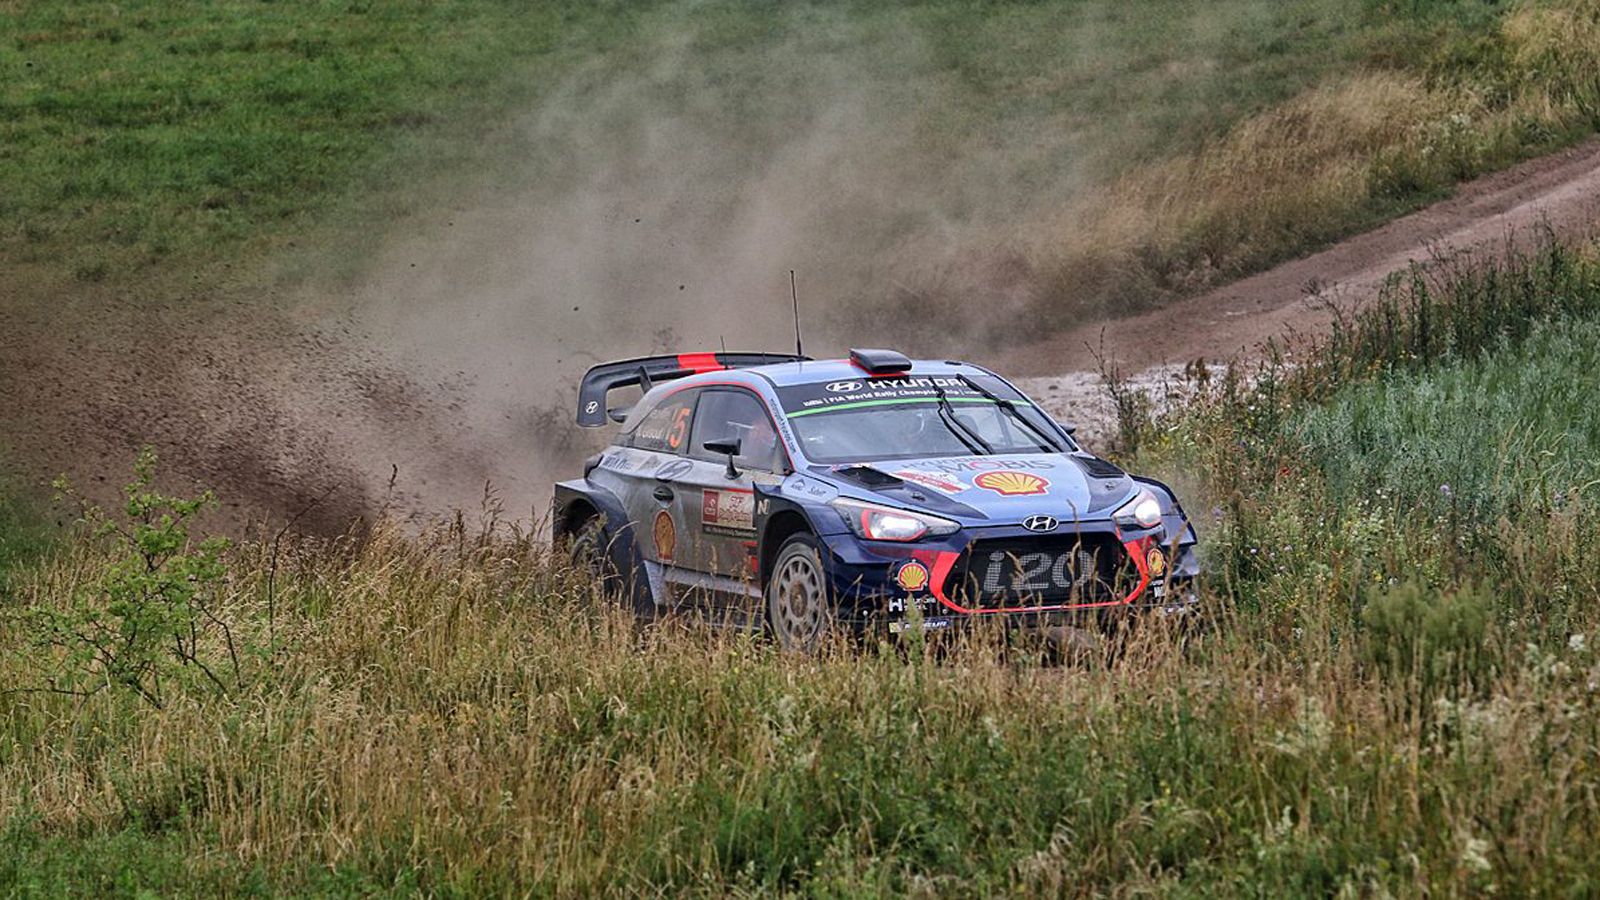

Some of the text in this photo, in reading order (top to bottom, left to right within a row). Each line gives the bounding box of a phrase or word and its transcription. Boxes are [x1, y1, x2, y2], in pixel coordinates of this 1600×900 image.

[867, 378, 968, 389] HYUNDAI
[845, 392, 873, 401] World
[873, 389, 897, 398] Rally
[898, 388, 959, 396] Championhip
[670, 407, 691, 448] 5
[937, 460, 1055, 474] MOBIS
[983, 550, 1096, 592] i20
